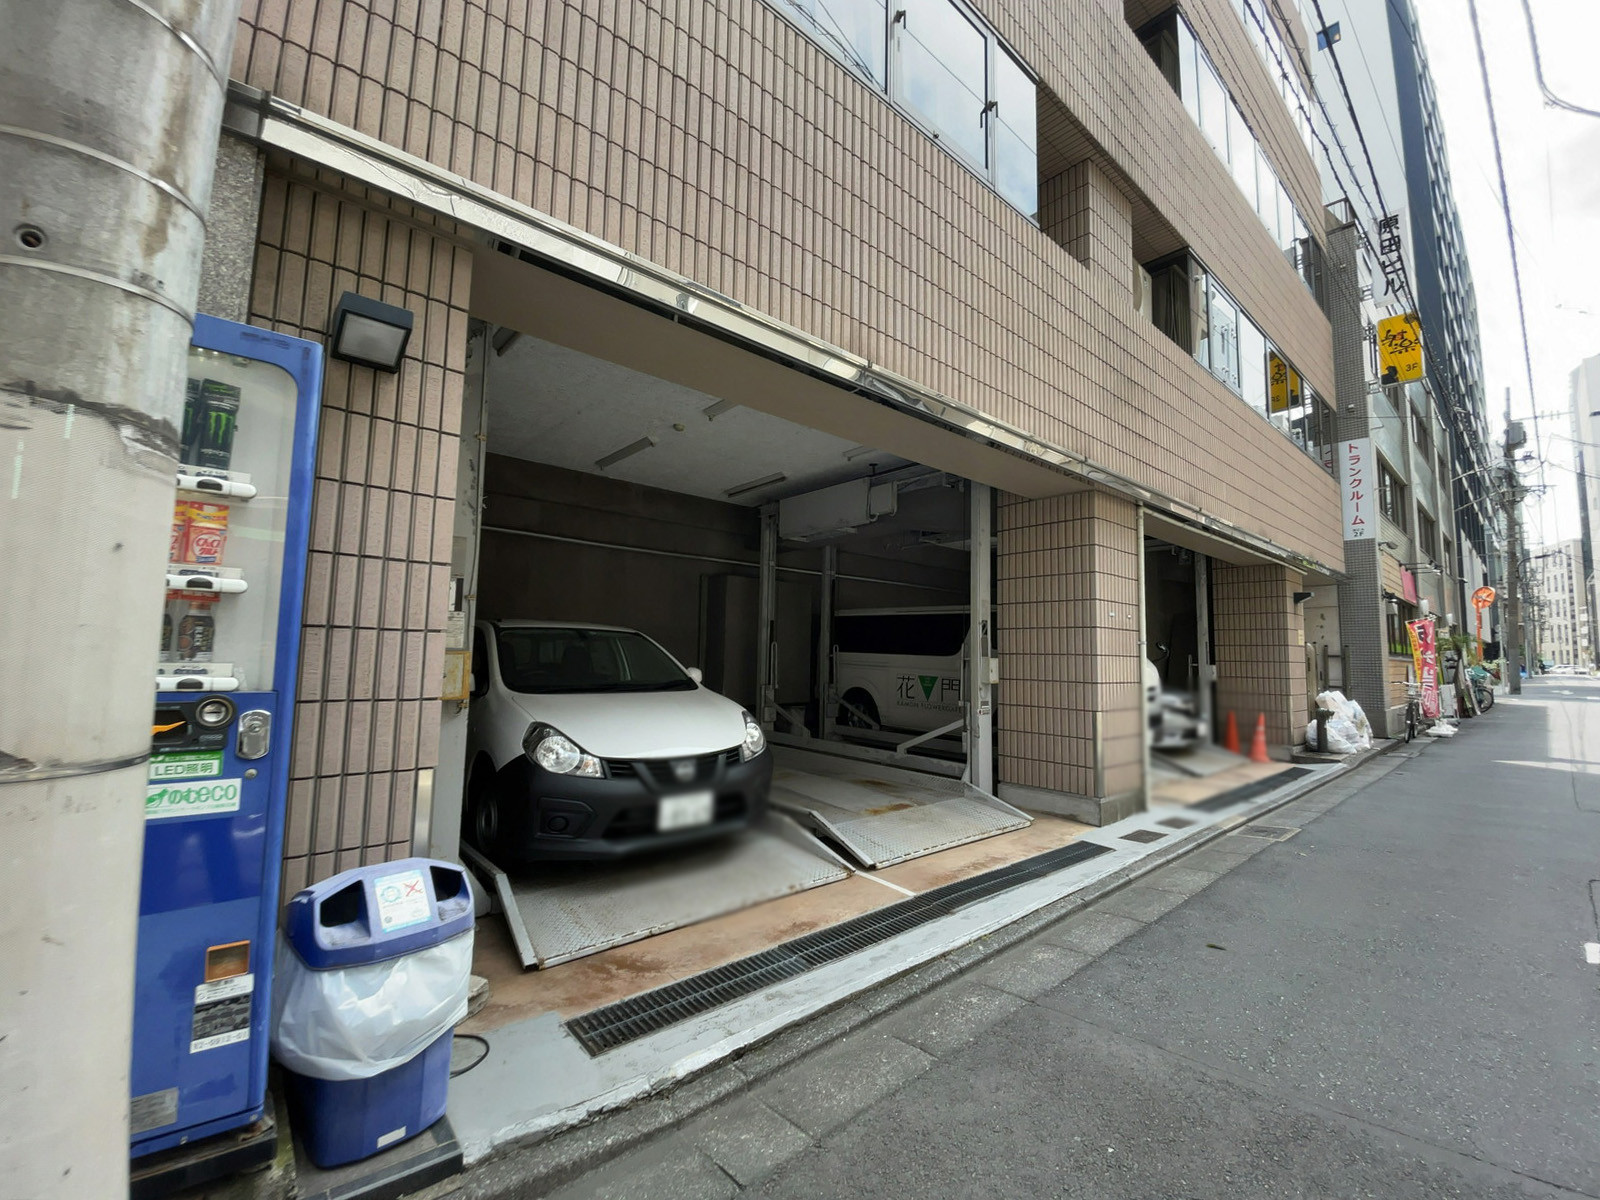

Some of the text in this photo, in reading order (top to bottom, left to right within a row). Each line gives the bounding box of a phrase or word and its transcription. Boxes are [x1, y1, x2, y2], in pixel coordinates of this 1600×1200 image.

[1379, 214, 1405, 297] 原田ビル
[1405, 362, 1418, 372] 3F
[1348, 443, 1366, 526] トランクルーム
[896, 675, 915, 700] 花
[154, 762, 215, 777] LED照明
